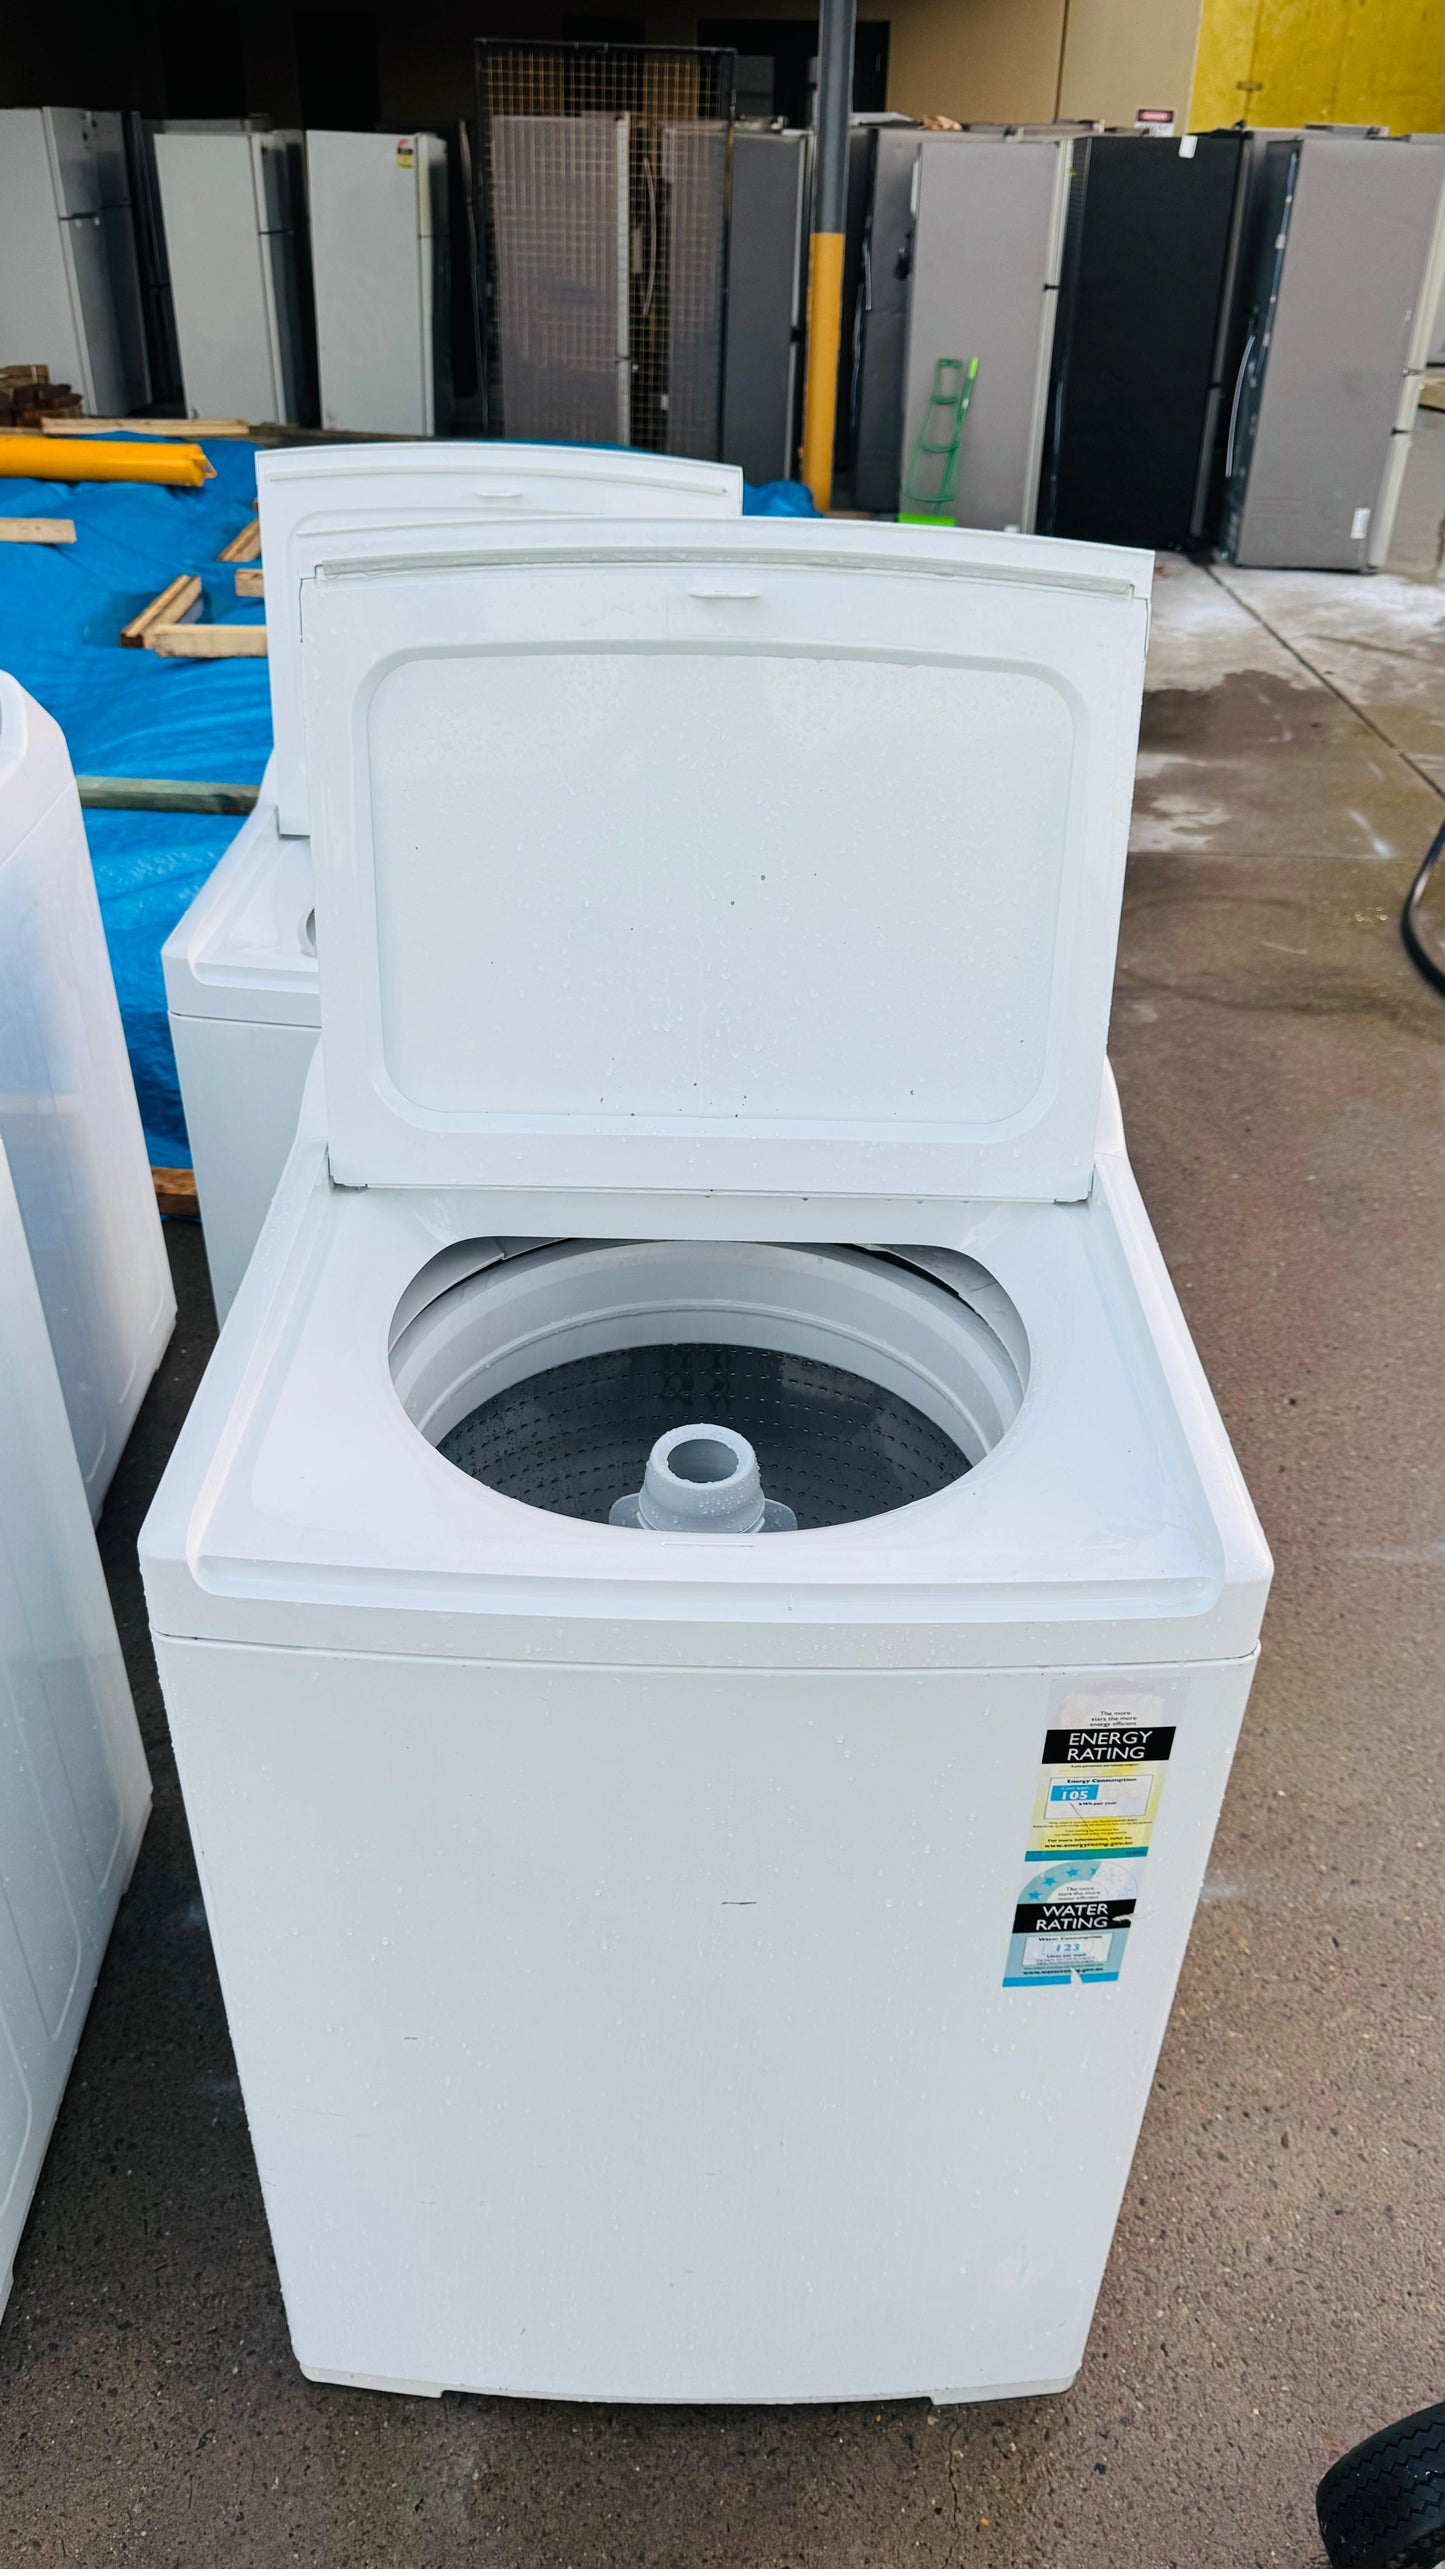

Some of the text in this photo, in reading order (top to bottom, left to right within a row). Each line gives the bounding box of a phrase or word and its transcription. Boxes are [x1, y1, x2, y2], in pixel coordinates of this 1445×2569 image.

[1068, 1730, 1153, 1746] ENERGY
[1067, 1746, 1146, 1761] RATING
[1061, 1790, 1089, 1800] 105
[1042, 1903, 1109, 1917] WATER
[1035, 1916, 1109, 1931] RATING
[1056, 1943, 1081, 1952] 123
